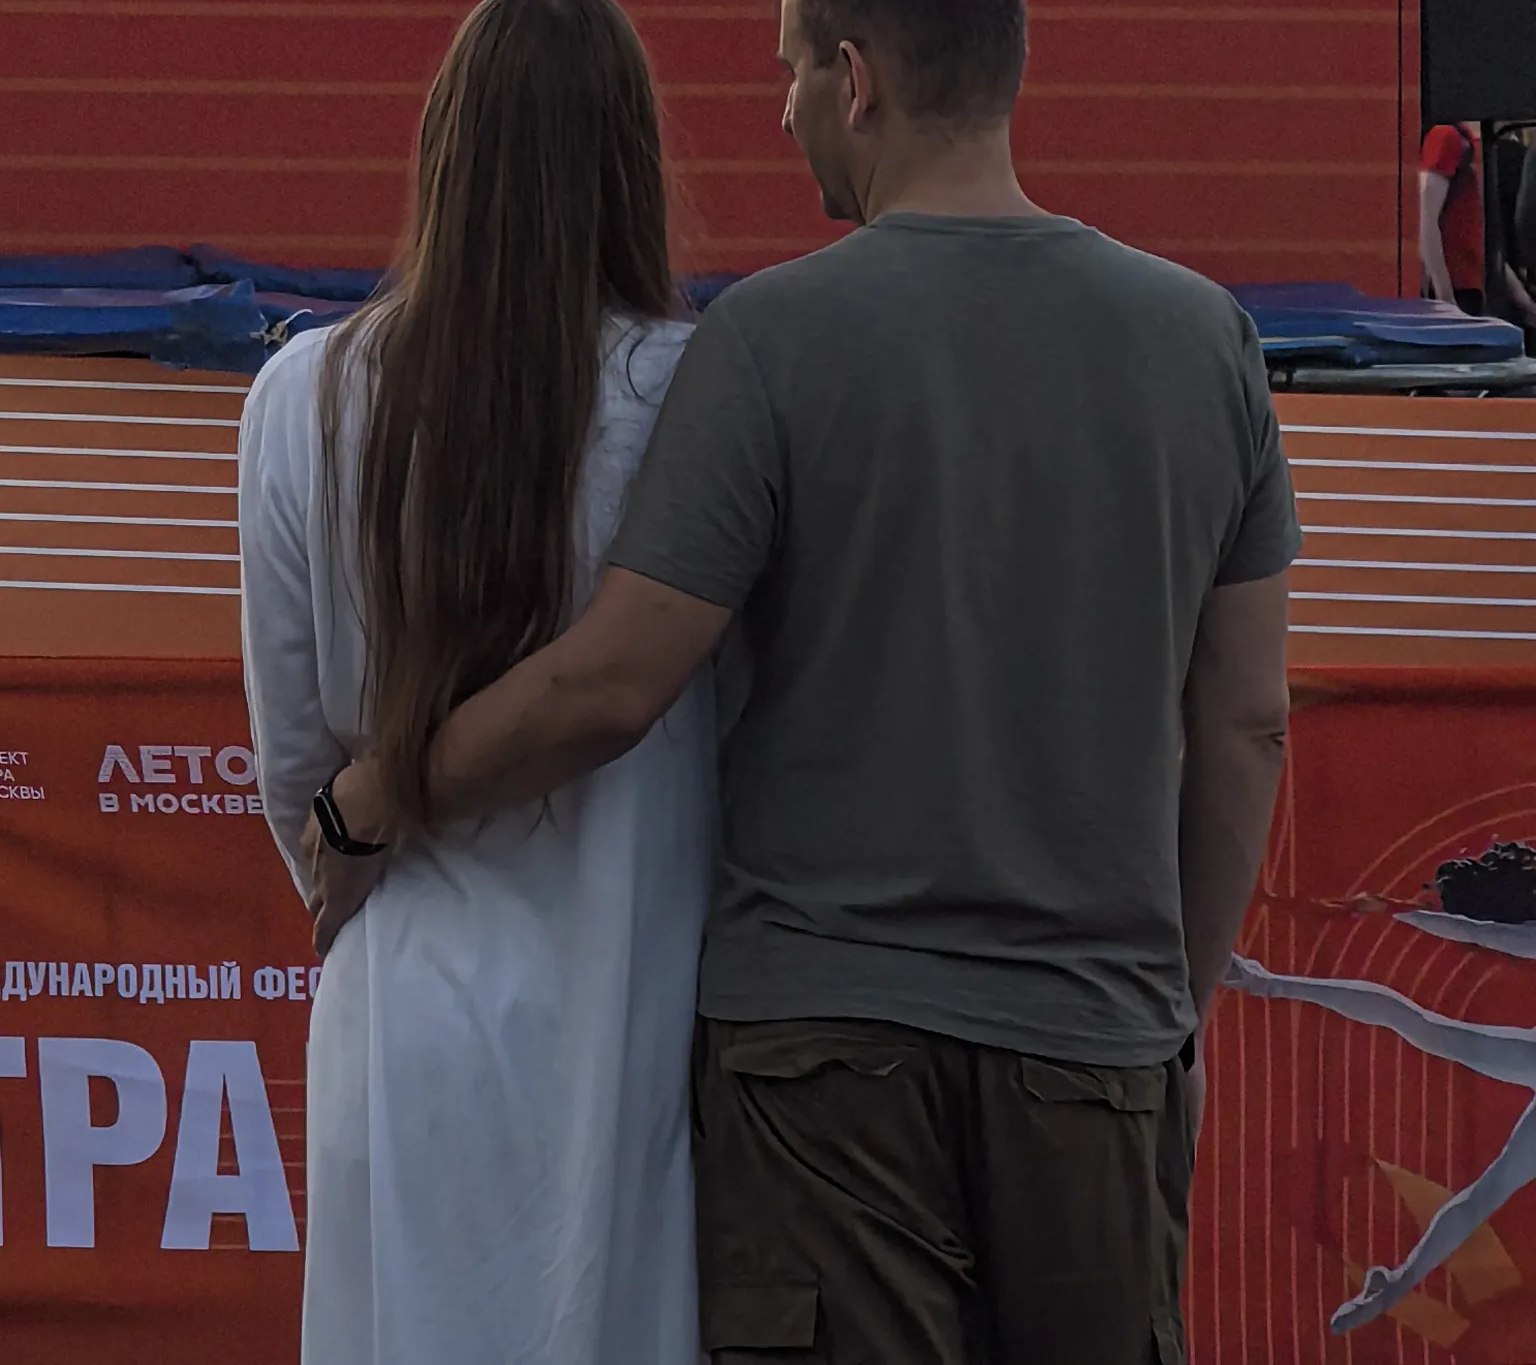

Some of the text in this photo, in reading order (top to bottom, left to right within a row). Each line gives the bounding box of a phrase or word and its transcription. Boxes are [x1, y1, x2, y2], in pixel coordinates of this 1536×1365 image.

[97, 744, 257, 786] ЛЕТО
[99, 793, 264, 815] В МОСКВЕ
